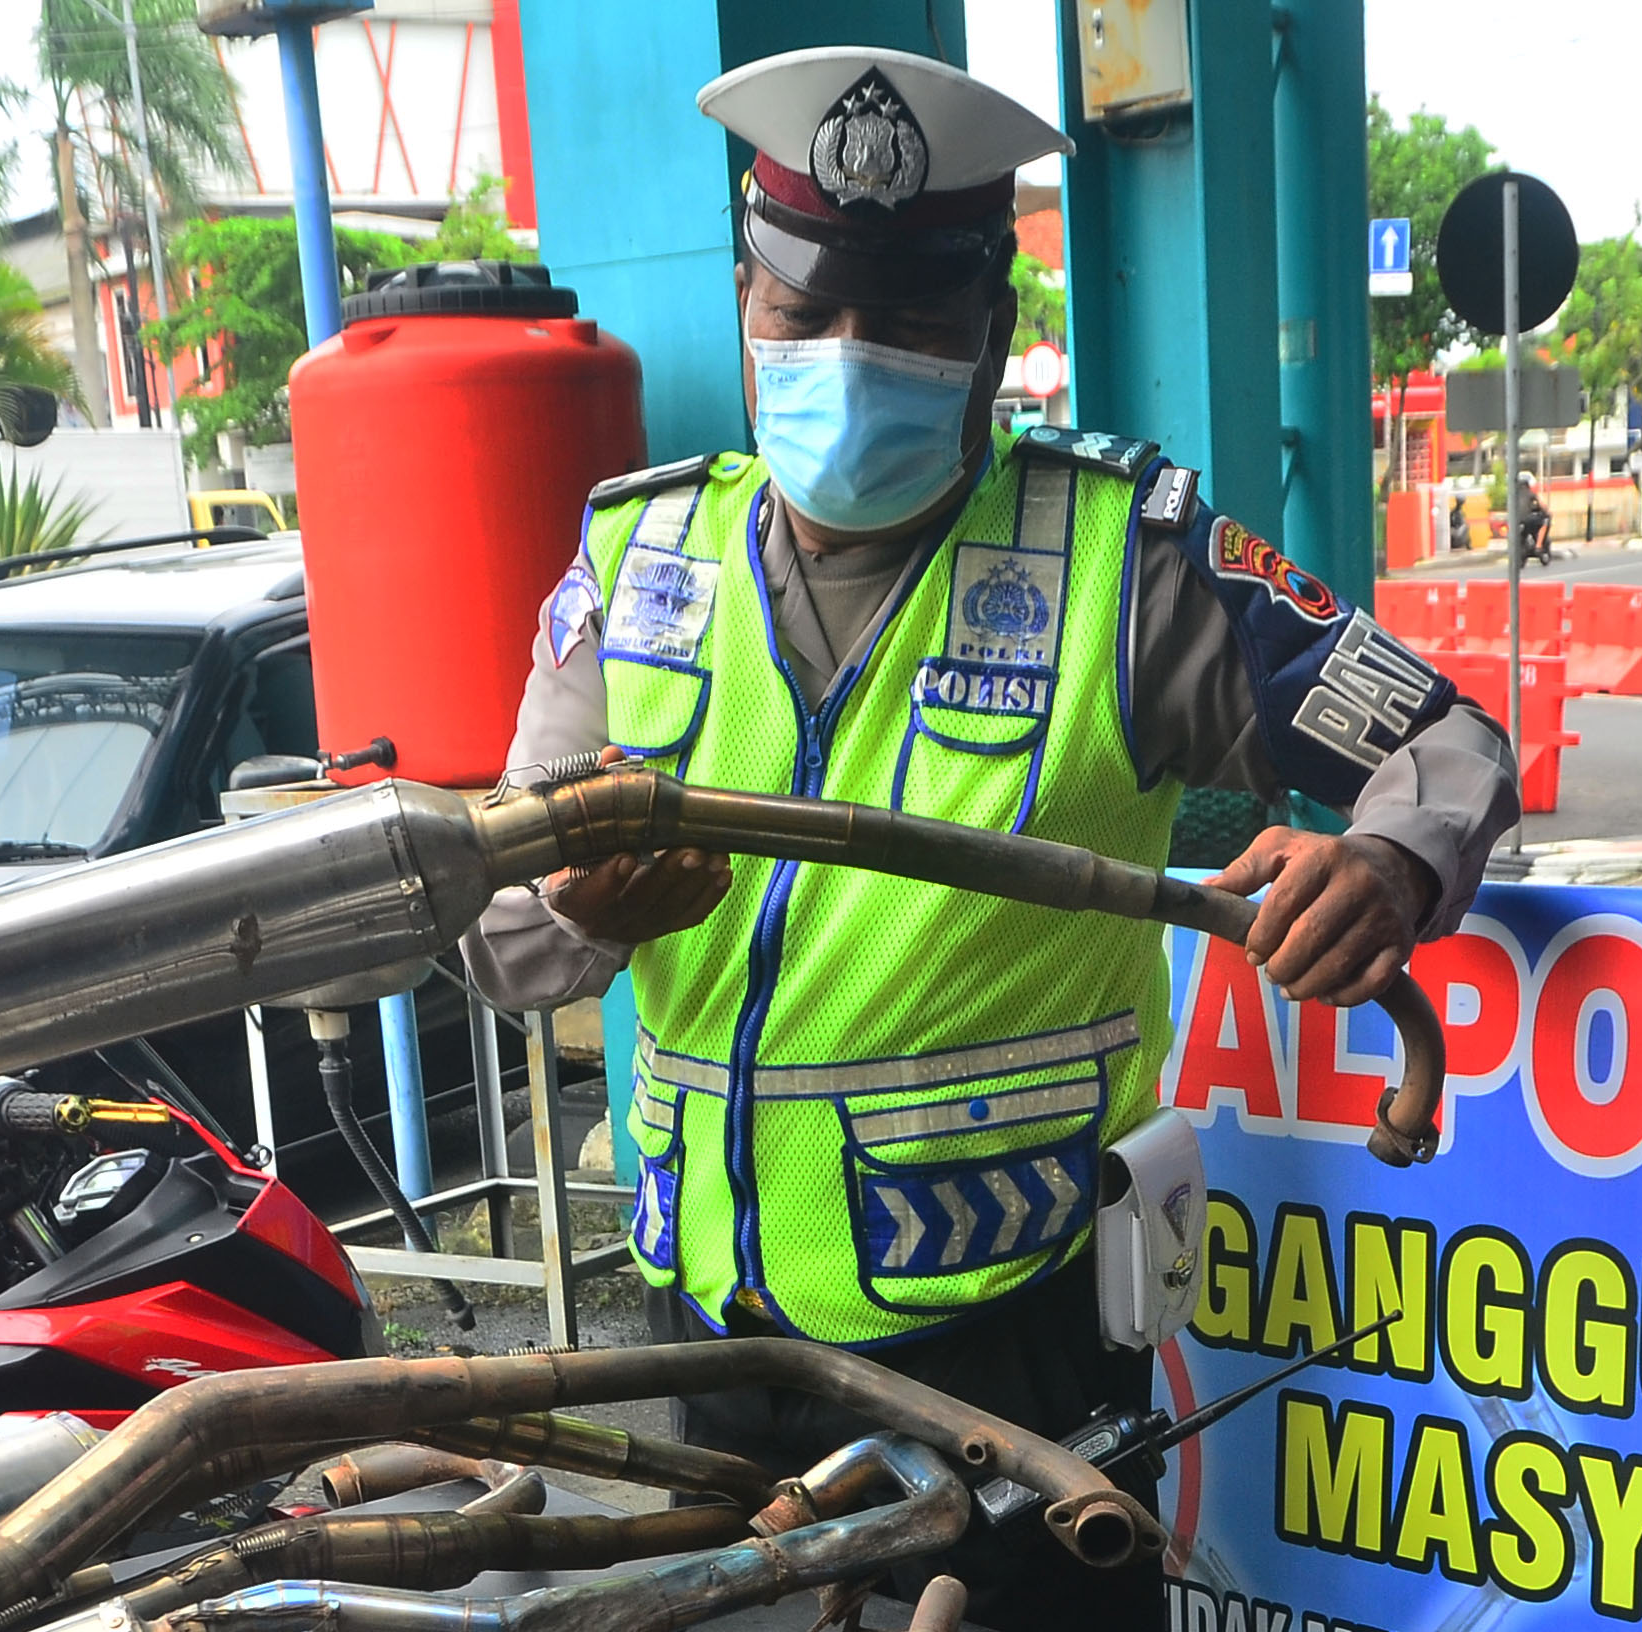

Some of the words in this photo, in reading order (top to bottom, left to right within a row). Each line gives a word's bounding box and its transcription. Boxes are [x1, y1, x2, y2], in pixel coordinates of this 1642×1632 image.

[959, 642, 1045, 661] POLRI
[912, 665, 1050, 714] POLISI
[1291, 607, 1439, 772] PAT
